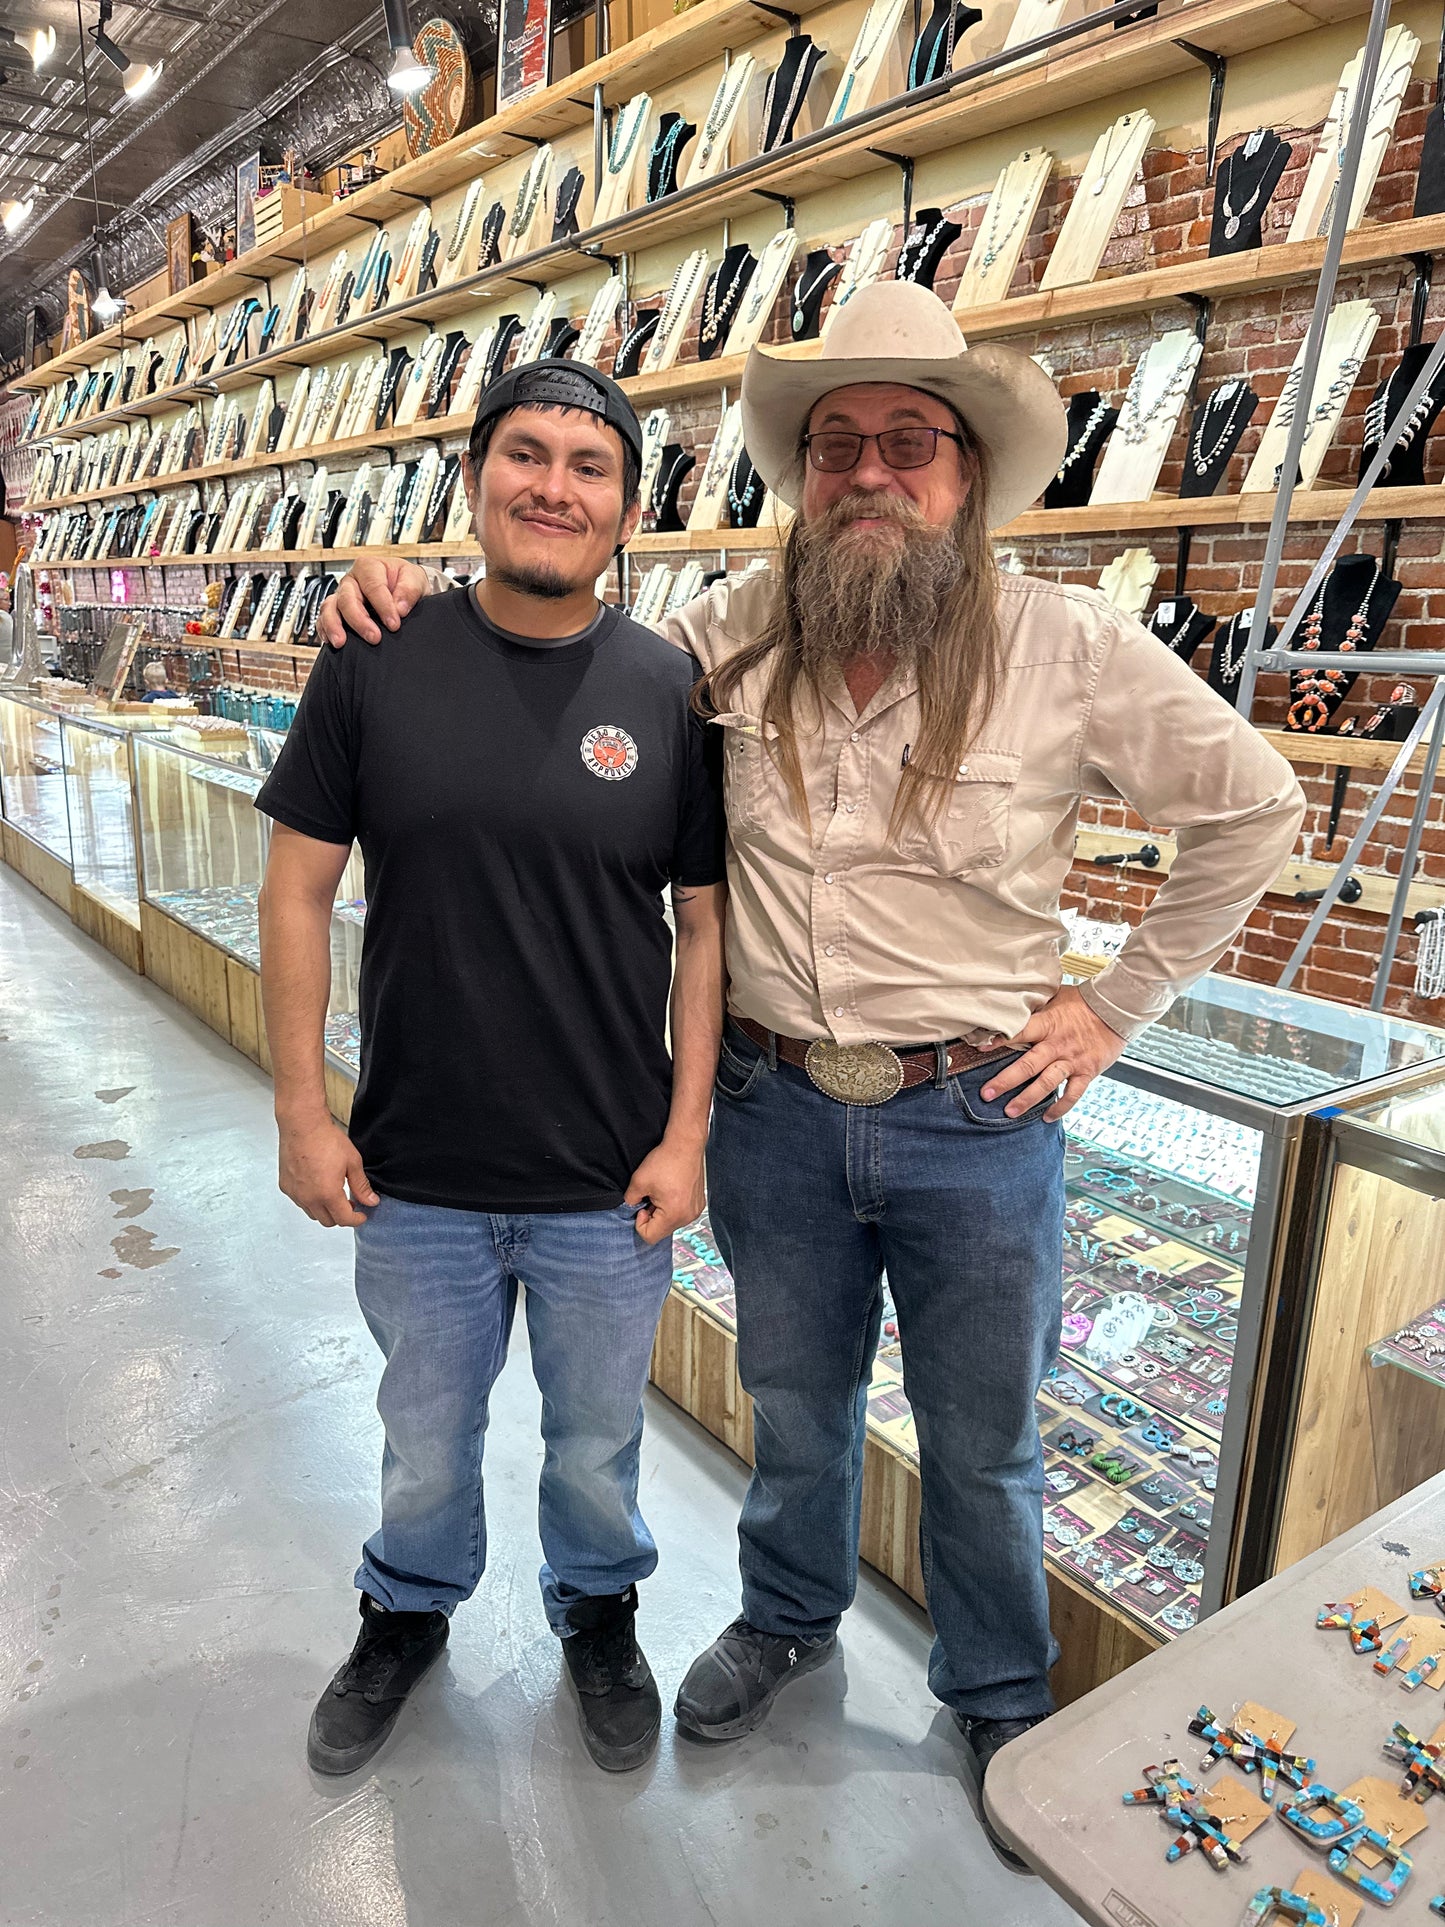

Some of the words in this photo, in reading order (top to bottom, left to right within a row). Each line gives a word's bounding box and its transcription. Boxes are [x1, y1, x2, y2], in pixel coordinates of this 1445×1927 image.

[615, 731, 633, 750] BULL
[587, 758, 632, 776] APPROVED
[1116, 1904, 1146, 1927] LIF
